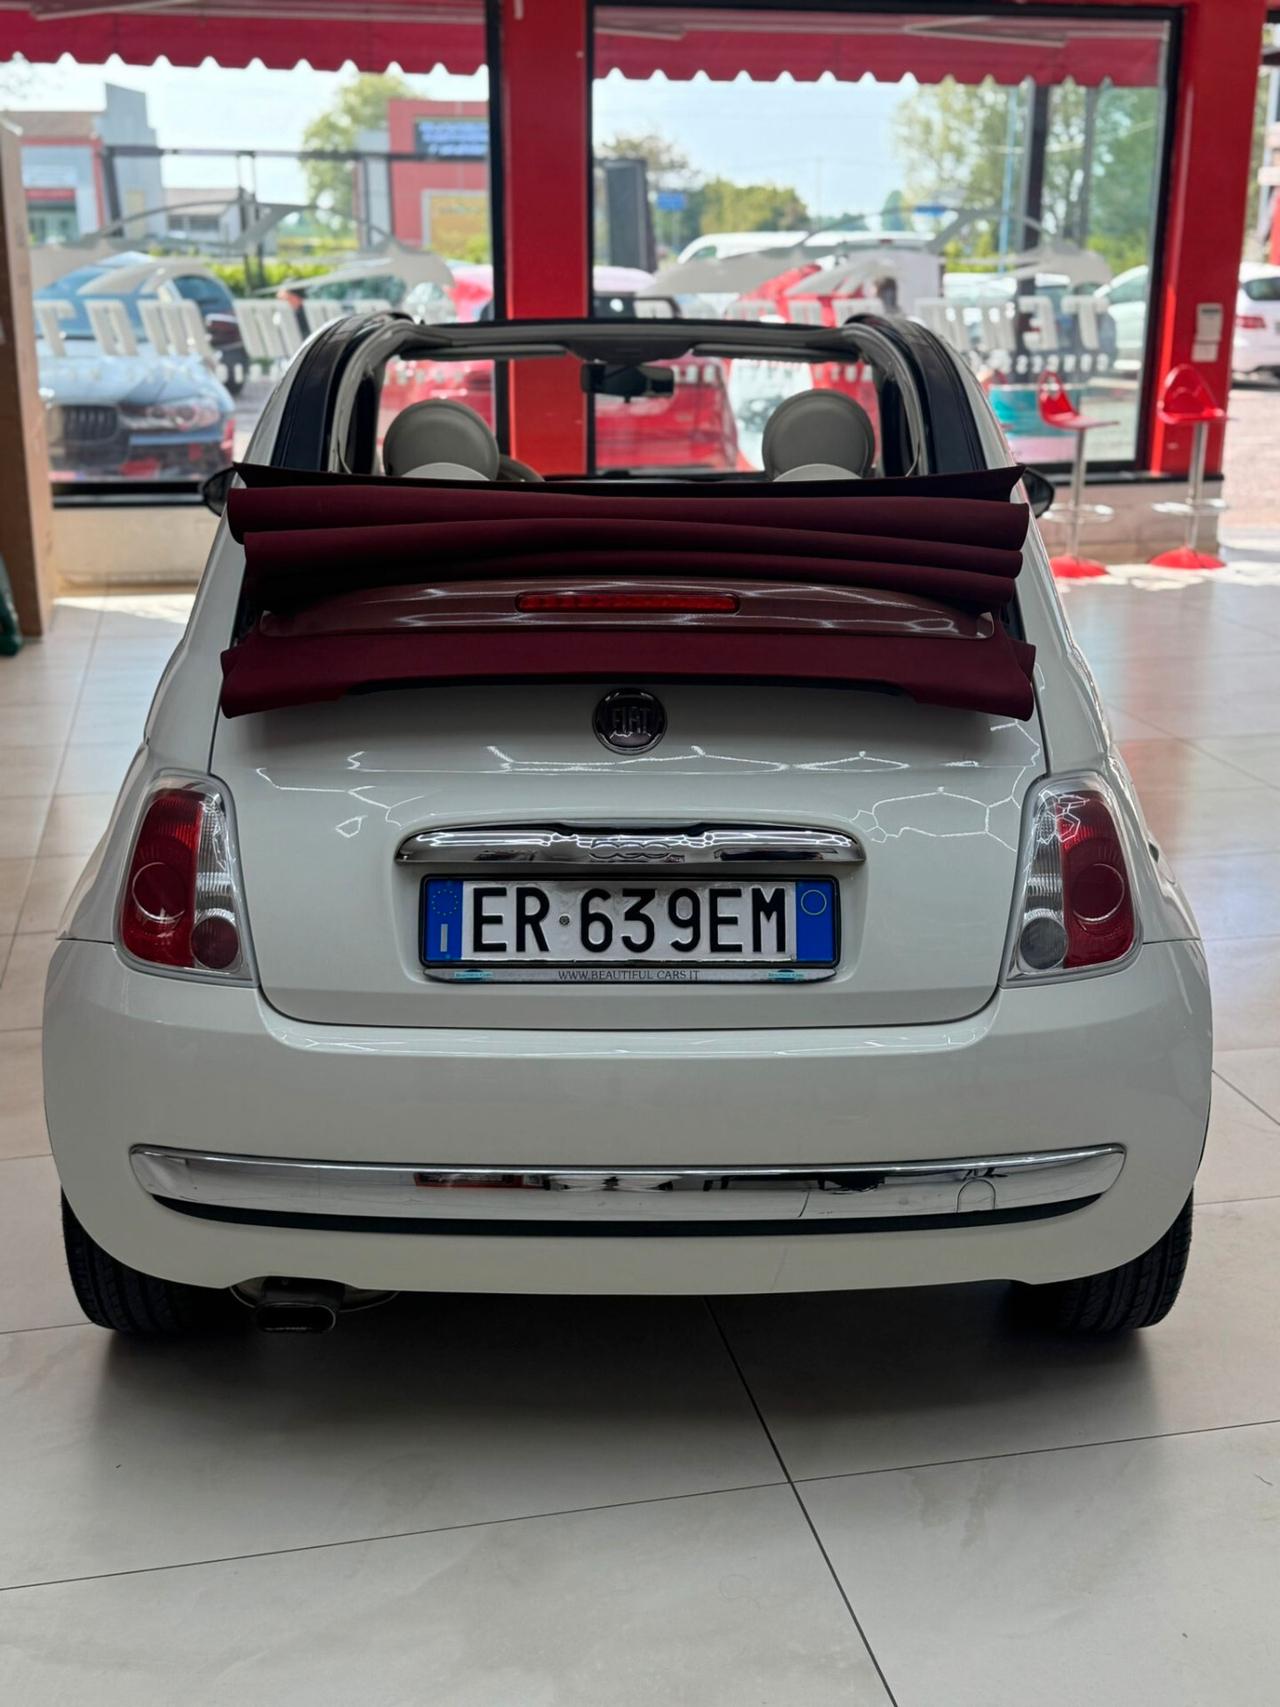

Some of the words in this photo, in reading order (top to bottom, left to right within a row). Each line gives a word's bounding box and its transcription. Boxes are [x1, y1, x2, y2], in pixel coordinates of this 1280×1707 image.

[612, 706, 651, 734] FIAT
[473, 887, 550, 953] ER
[581, 887, 787, 953] 639EM
